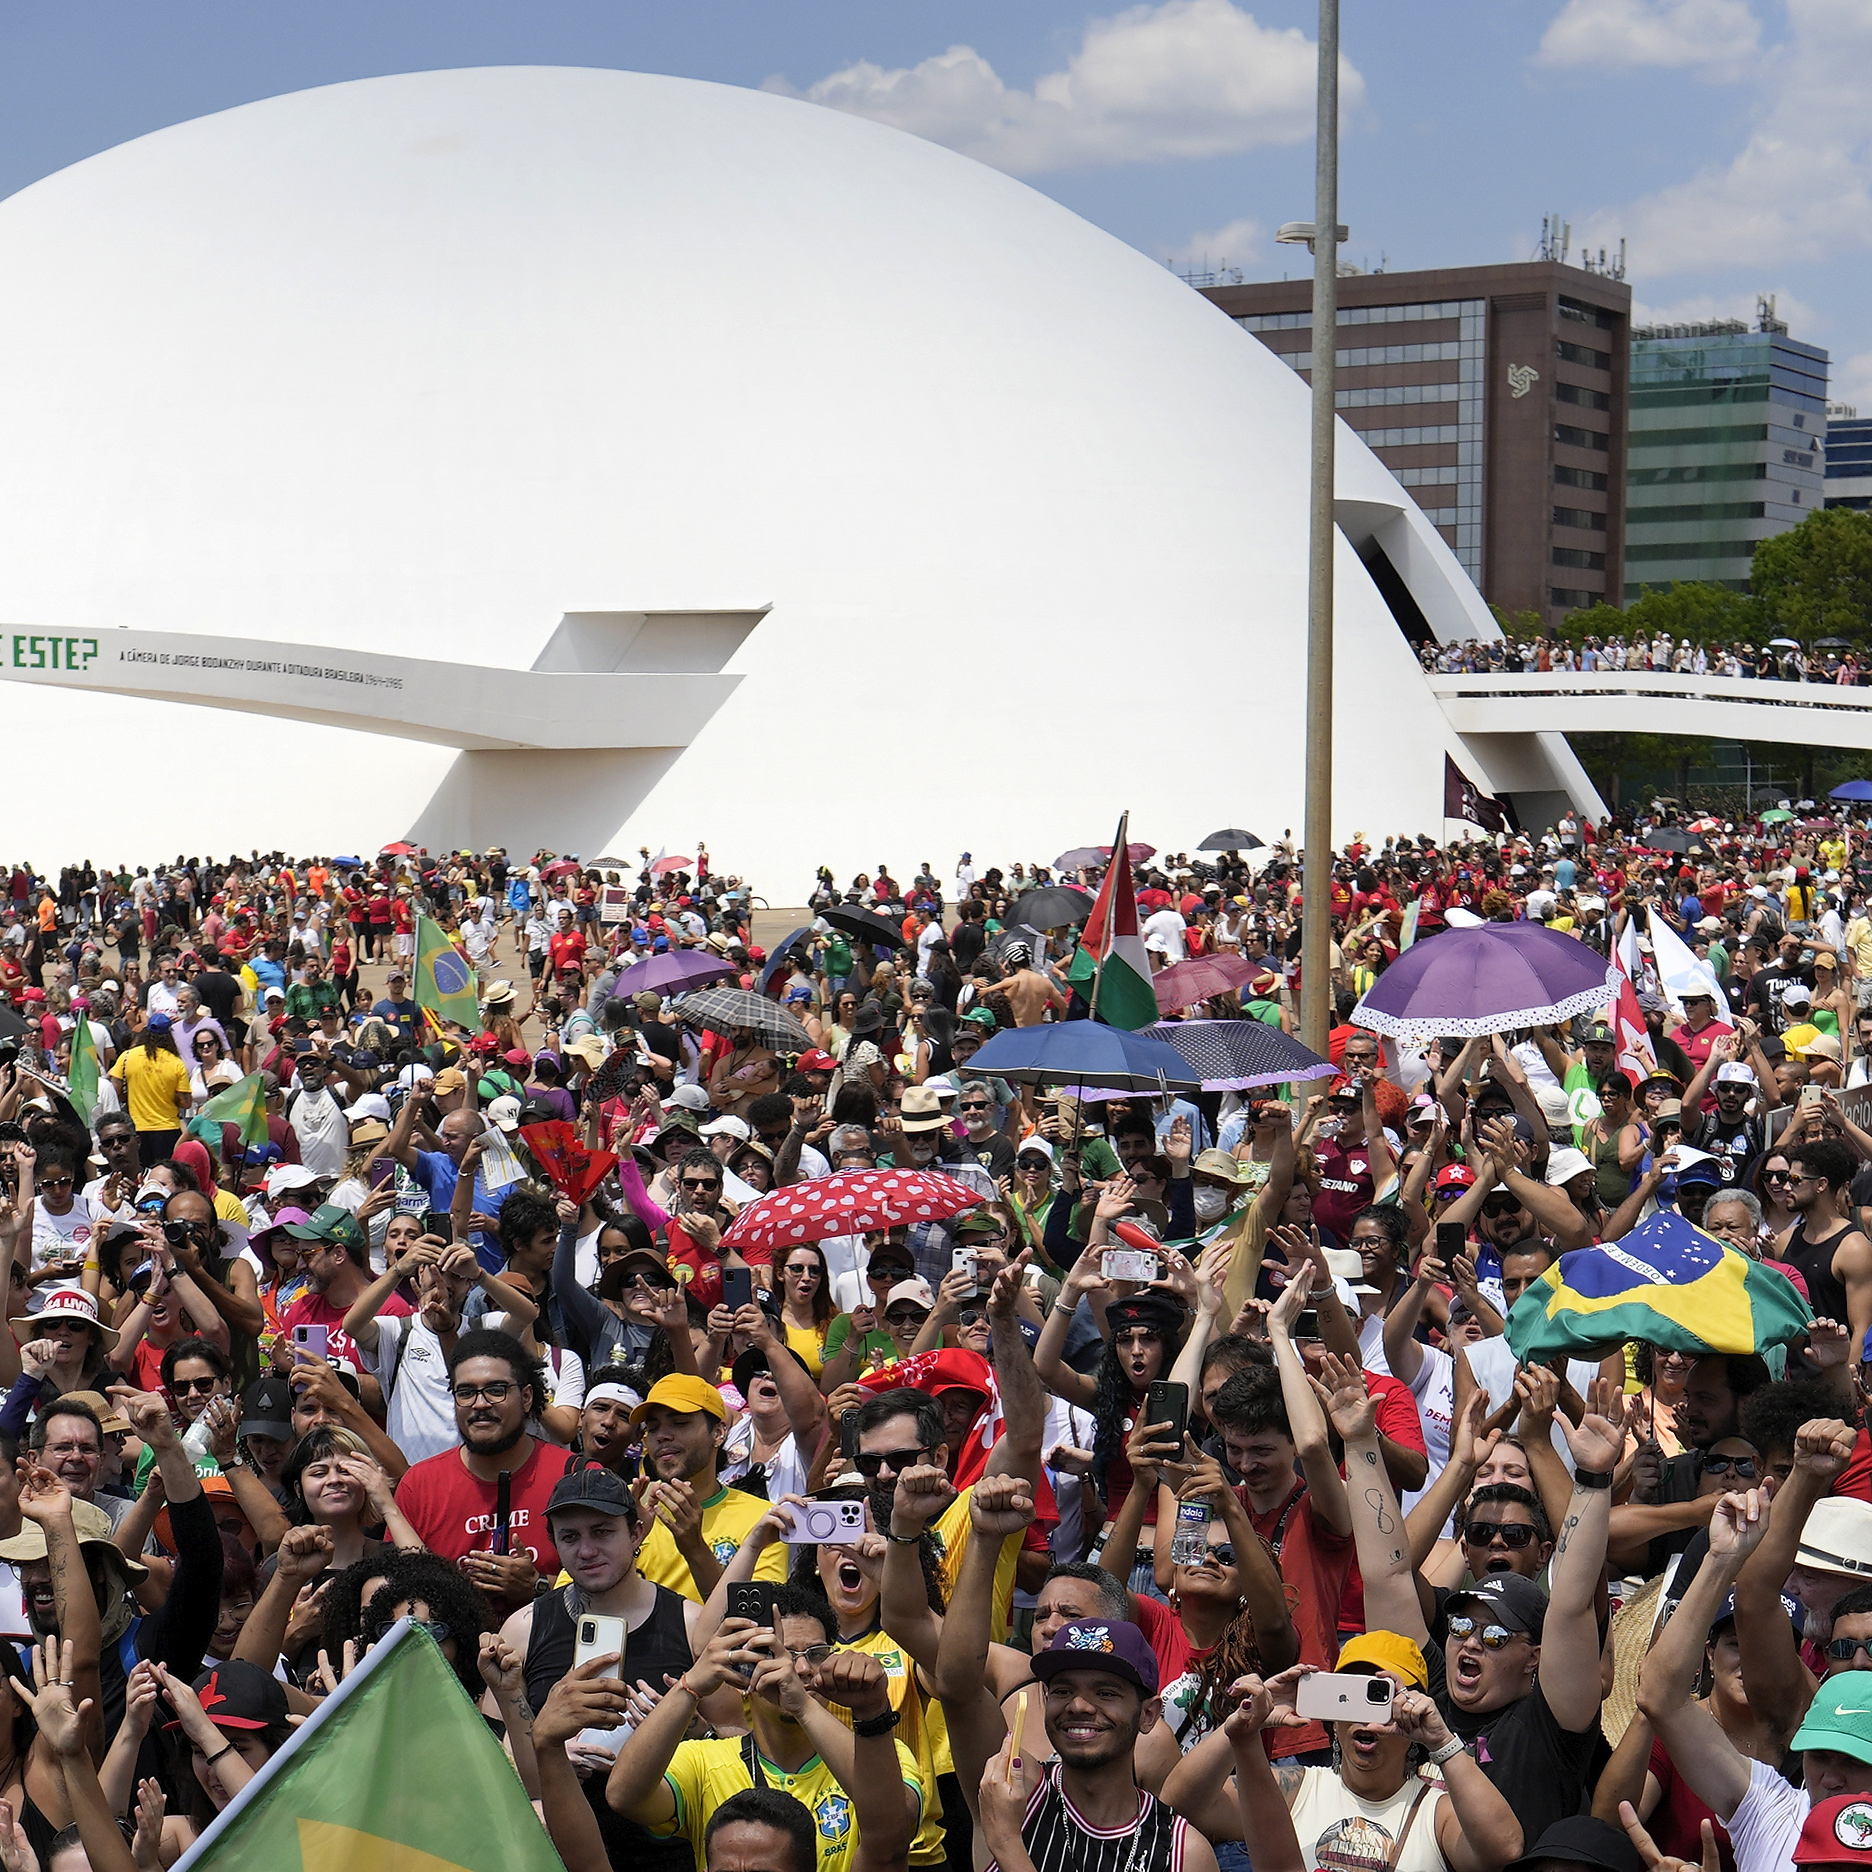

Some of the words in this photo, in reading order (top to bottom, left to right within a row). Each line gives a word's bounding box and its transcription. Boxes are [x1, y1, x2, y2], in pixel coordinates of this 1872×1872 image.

[13, 635, 98, 670] ESTE?
[120, 651, 126, 661] A
[159, 653, 171, 664] DE
[172, 655, 200, 667] JORGE
[246, 660, 282, 673] DURANTE
[324, 668, 364, 683] BRASILEIRA
